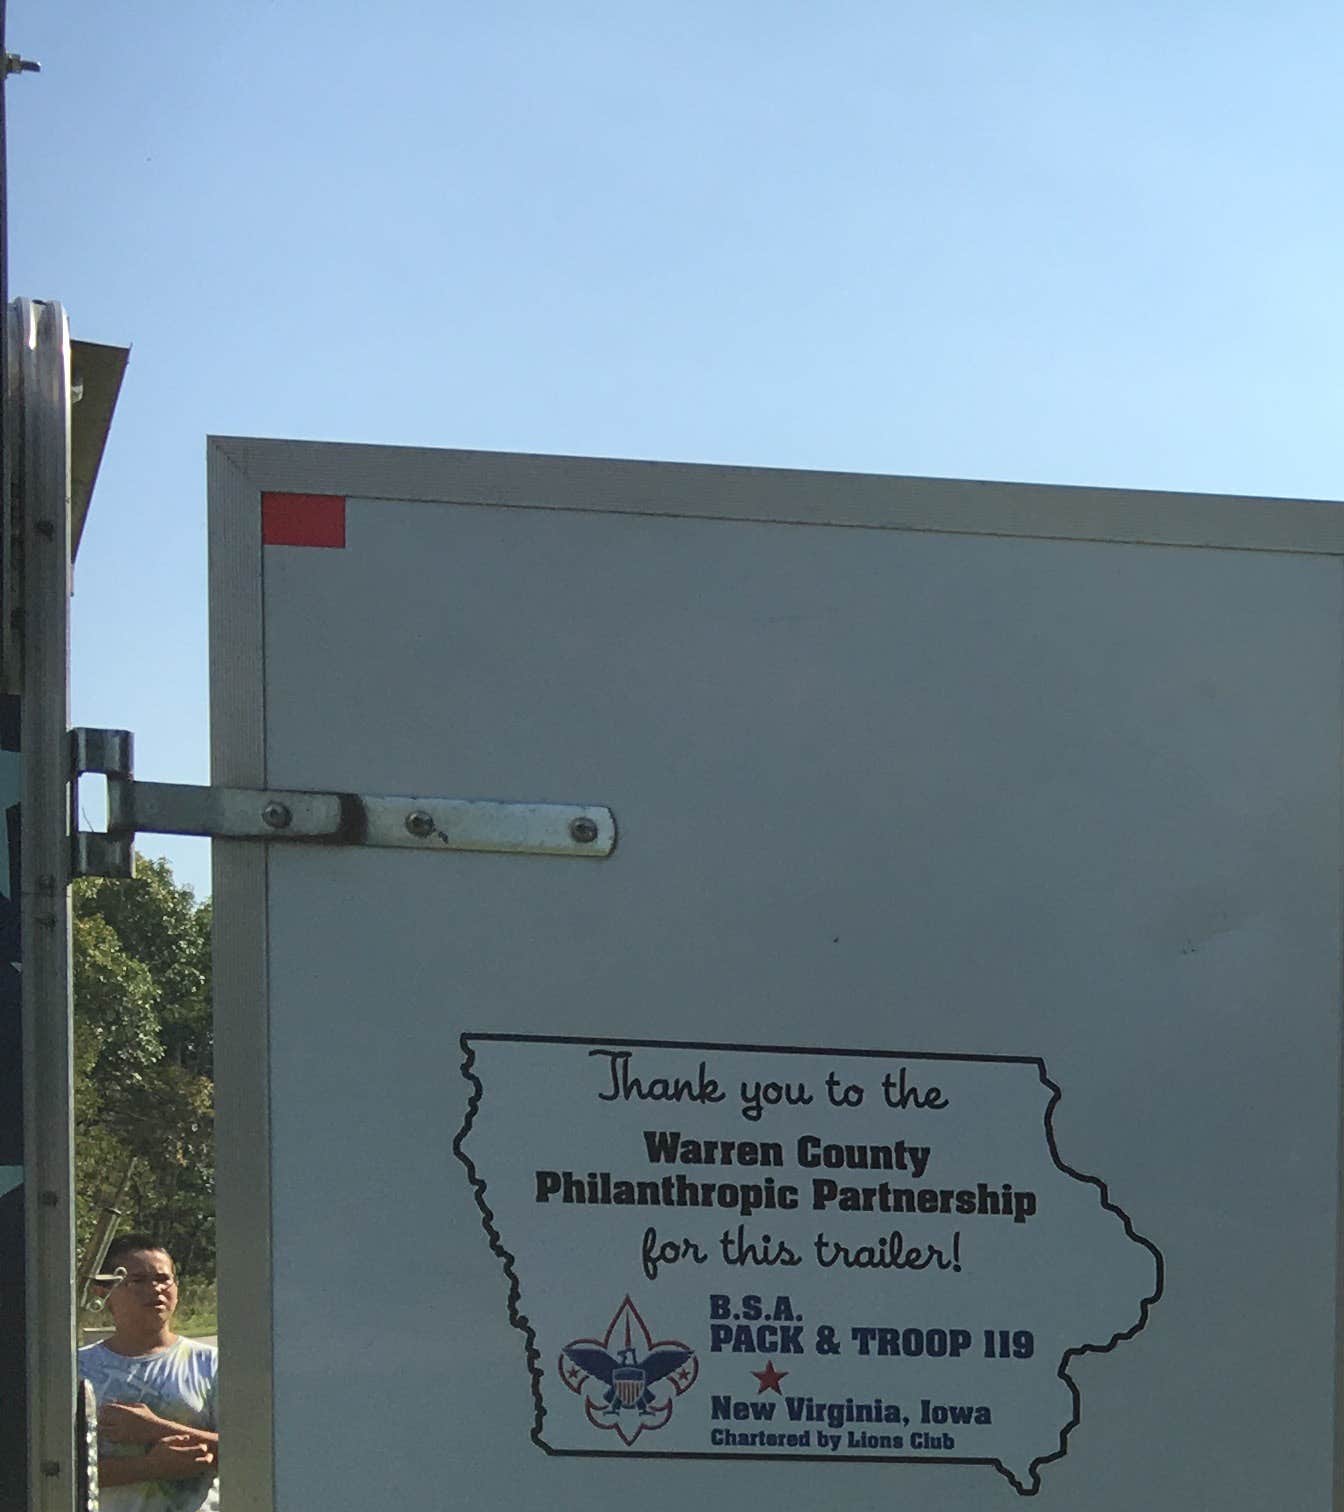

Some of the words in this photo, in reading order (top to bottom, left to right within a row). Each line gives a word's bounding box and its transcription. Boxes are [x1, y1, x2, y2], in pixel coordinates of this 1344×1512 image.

[589, 1049, 726, 1104] Thank
[740, 1080, 813, 1121] you
[825, 1071, 865, 1107] to
[881, 1067, 950, 1110] the
[643, 1131, 783, 1167] Warren
[797, 1135, 931, 1178] County
[535, 1170, 799, 1216] Philanthropic
[812, 1178, 1037, 1224] Partnership
[641, 1226, 708, 1280] for
[719, 1223, 802, 1267] this
[814, 1231, 962, 1273] trailer!
[709, 1294, 803, 1322] B.S.A.
[710, 1323, 804, 1355] PACK
[815, 1325, 841, 1356] &
[851, 1327, 972, 1358] TROOP
[983, 1329, 1035, 1360] 119
[711, 1395, 776, 1421] New
[785, 1397, 909, 1428] Virginia,
[920, 1399, 992, 1425] Iowa
[711, 1428, 810, 1448] Chartered
[817, 1430, 841, 1451] by
[847, 1431, 903, 1450] Lions
[910, 1432, 955, 1450] Club
